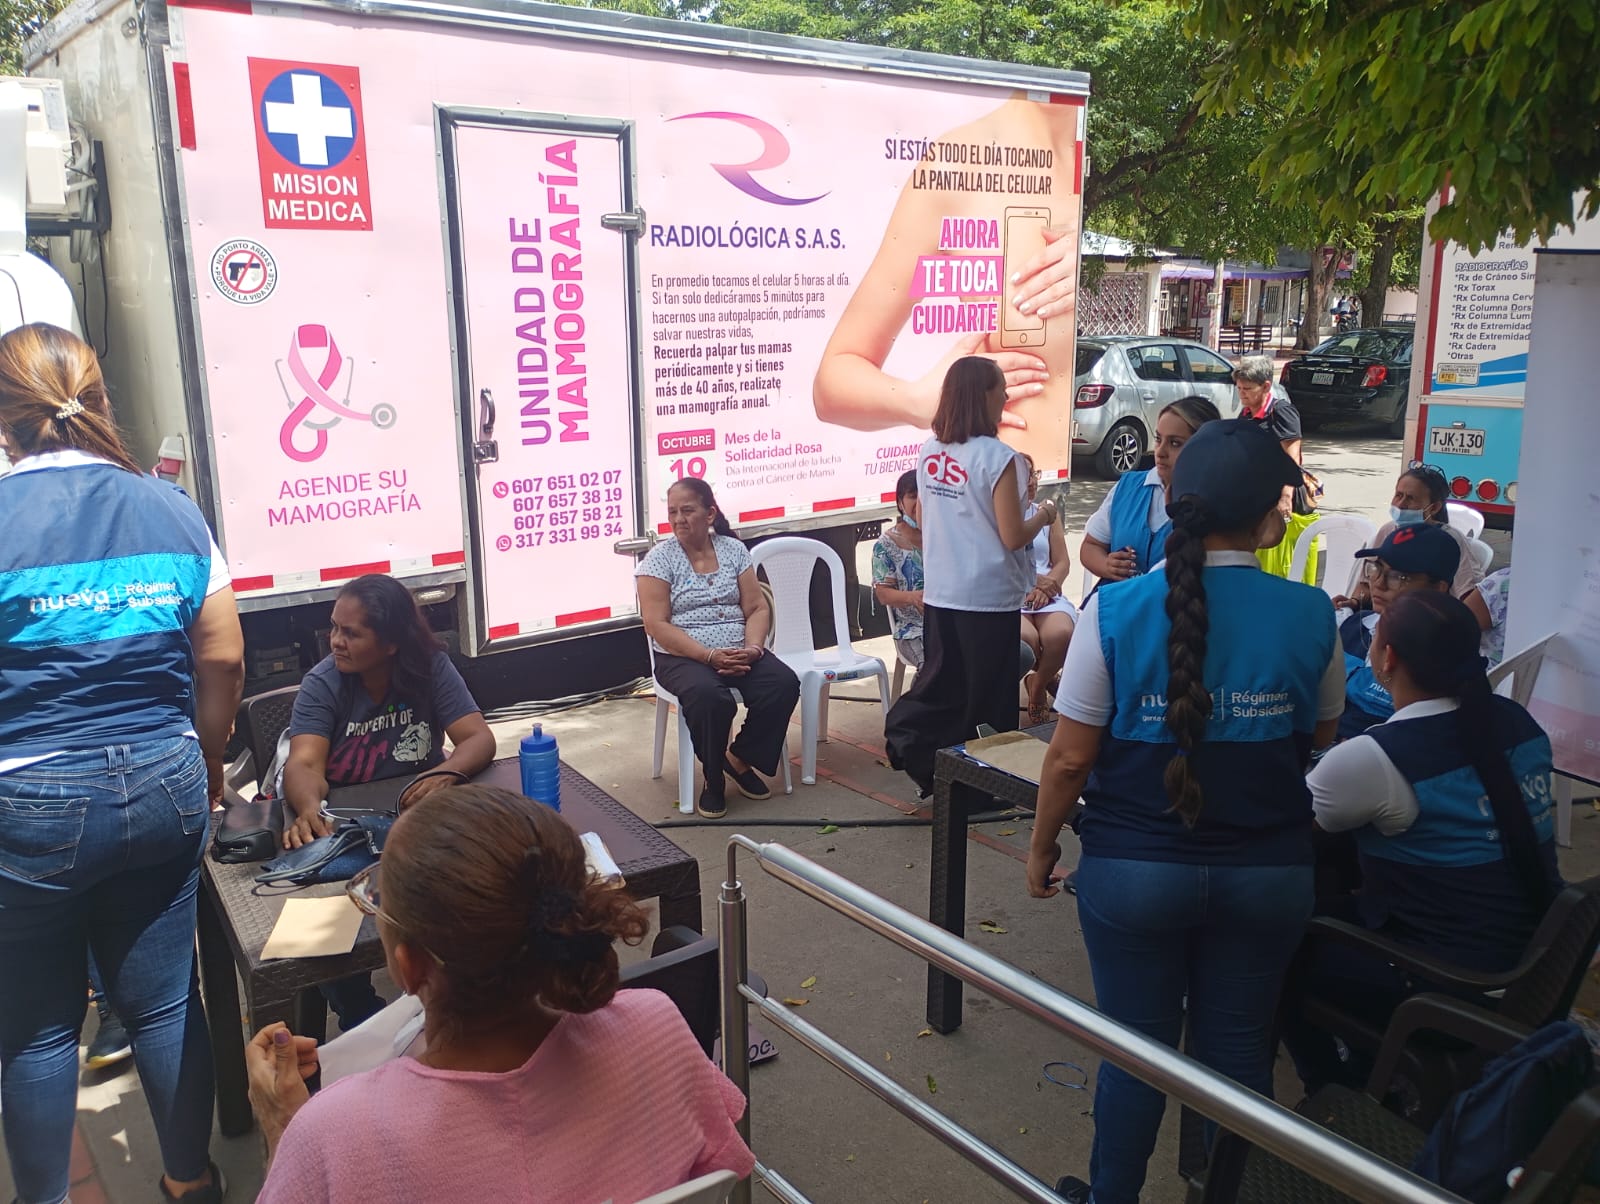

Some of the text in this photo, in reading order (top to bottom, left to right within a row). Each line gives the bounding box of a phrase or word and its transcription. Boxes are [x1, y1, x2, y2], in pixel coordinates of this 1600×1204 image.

[885, 137, 1053, 168] SI ESTÁS TODO EL DÍA TOCANDO
[273, 172, 358, 196] MISION
[913, 169, 1052, 195] LA PANTALLA DEL CELULAR
[267, 198, 367, 222] MEDICA
[651, 220, 846, 249] RADIOLÓGICA S.A.S.
[940, 218, 999, 249] AHORA
[216, 243, 272, 267] NO PORTO ARMAS
[1455, 259, 1529, 272] RADIOGRAFÍAS
[215, 270, 237, 298] PORQUE
[249, 290, 266, 301] VIDA
[264, 273, 275, 290] VALE
[652, 274, 663, 287] En
[666, 274, 709, 290] promedio
[712, 274, 749, 287] tocamos
[752, 274, 760, 286] el
[762, 274, 791, 286] celular
[794, 273, 800, 286] 5
[801, 273, 824, 286] horas
[827, 273, 835, 286] al
[923, 260, 998, 293] TE TOCA
[1472, 273, 1483, 281] de
[538, 139, 589, 442] MAMOGRAFÍA
[652, 291, 661, 304] Si
[664, 292, 679, 304] tan
[682, 291, 701, 304] solo
[704, 289, 760, 304] dedicáramos
[763, 290, 769, 302] 5
[806, 292, 824, 304] para
[653, 305, 825, 324] hacernos una autopalpación, podríamos
[913, 303, 998, 335] CUIDARTE
[509, 217, 551, 446] UNIDAD DE
[653, 325, 753, 341] salvar nuestras vidas,
[1466, 332, 1477, 340] de
[1467, 322, 1478, 330] de
[654, 342, 792, 360] Recuerda palpar tus mamas
[1465, 342, 1496, 350] Cadera
[655, 359, 784, 382] periódicamente y si tienes
[656, 377, 781, 397] más de 40 años, realizate
[656, 405, 675, 416] una
[679, 396, 738, 415] mamografía
[662, 435, 711, 449] OCTUBRE
[725, 428, 781, 445] Mes de la
[725, 443, 822, 462] Solidaridad Rosa
[726, 454, 842, 476] Día Internacional de la lucha
[864, 463, 878, 476] TU
[279, 469, 407, 500] AGENDE SU
[512, 470, 622, 494] 607 651 02 07
[726, 468, 835, 489] contra el Cáncer de Mama
[268, 489, 421, 527] MAMOGRAFÍA
[513, 487, 622, 512] 607 657 38 19
[514, 505, 623, 530] 607 657 58 21
[515, 522, 623, 548] 317 331 99 34
[30, 588, 110, 613] nueva
[1231, 690, 1288, 705] Régimen
[400, 709, 413, 725] OF
